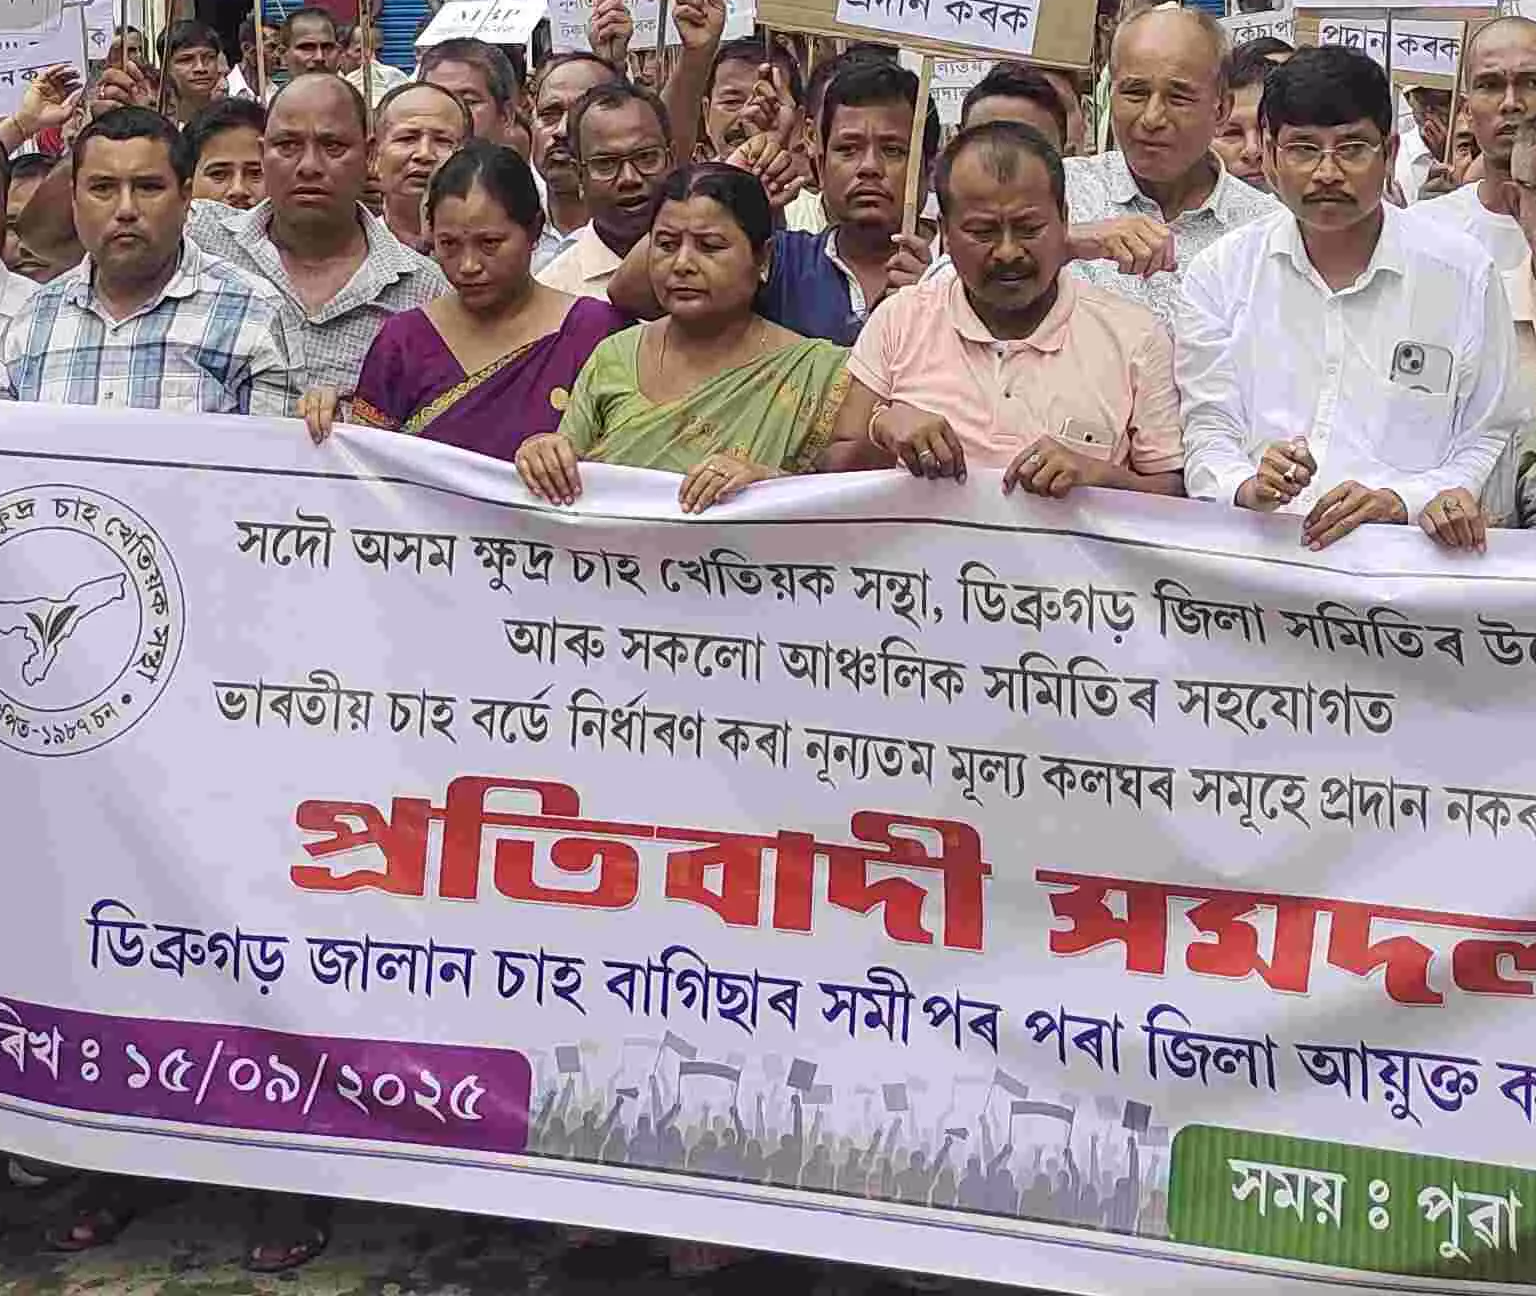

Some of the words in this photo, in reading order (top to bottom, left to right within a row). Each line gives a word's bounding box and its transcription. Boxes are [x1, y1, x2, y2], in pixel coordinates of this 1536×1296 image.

[1396, 33, 1461, 61] কৰক
[235, 506, 333, 568] সদৌ
[350, 524, 456, 575] অসম
[472, 532, 552, 596] ক্ষুদ্ৰ
[569, 544, 644, 594] চাহ
[661, 548, 837, 606] খেতিয়ক
[1152, 578, 1267, 645] জিলা
[1282, 607, 1467, 668] সমিতিৰ
[504, 614, 607, 666] আৰু
[619, 621, 766, 688] সকলো
[776, 635, 965, 708] আঞ্চলিক
[983, 648, 1158, 722] সমিতিৰ
[1176, 679, 1394, 736] সহযোগত
[215, 667, 372, 734] ভাৰতীয়
[389, 689, 457, 745] চাহ
[471, 683, 552, 746] বৰ্ডে
[719, 719, 792, 771] কৰা
[948, 745, 1027, 805] মূল্য
[1040, 756, 1175, 813] কলঘৰ
[1190, 768, 1312, 838] সমূহে
[1319, 776, 1431, 833] প্ৰদান
[289, 772, 994, 957] প্ৰতিবাদী
[305, 933, 474, 1001] জালান
[496, 949, 586, 1008] চাহ
[604, 942, 802, 1034] বাগিছাৰ
[1024, 1004, 1126, 1072] পৰা
[1141, 1002, 1277, 1089] জিলা
[124, 1046, 488, 1127] ১৫/০৯/২০২৫
[1229, 1157, 1345, 1228] সময়
